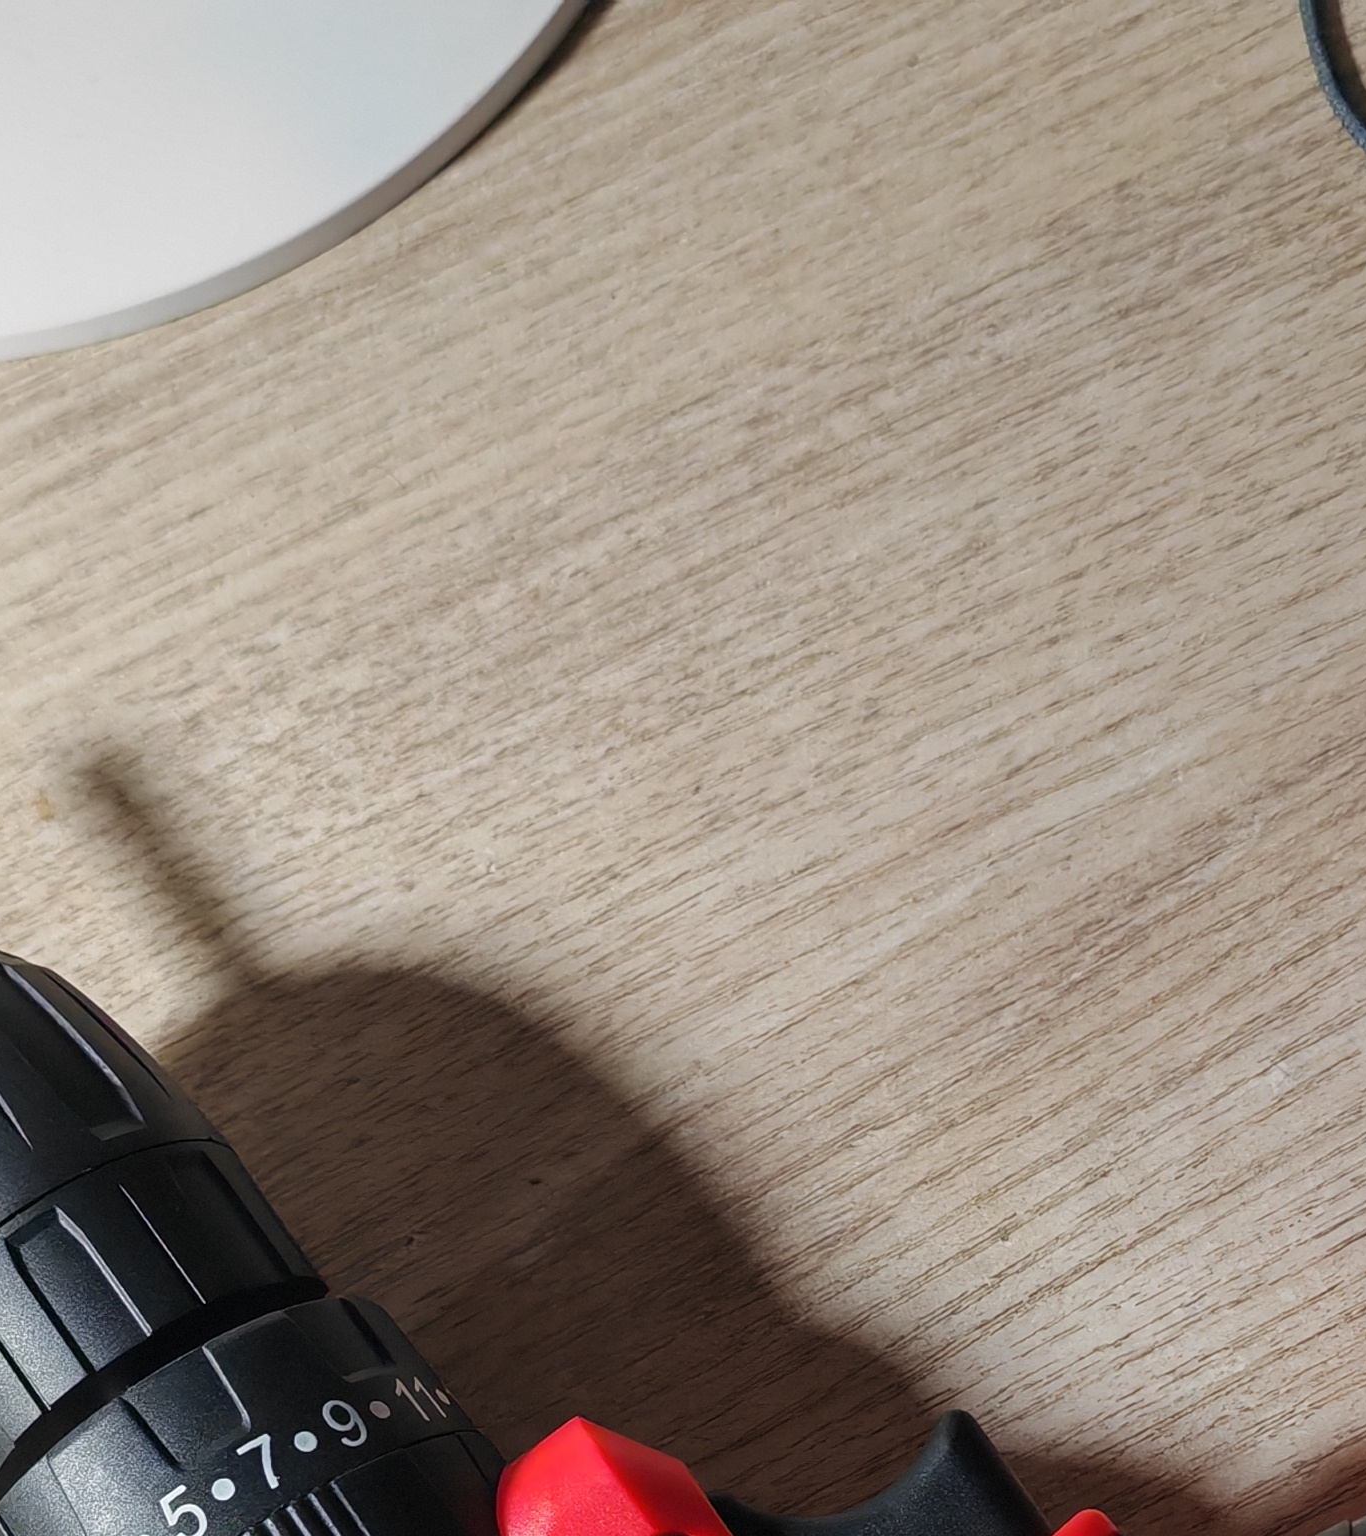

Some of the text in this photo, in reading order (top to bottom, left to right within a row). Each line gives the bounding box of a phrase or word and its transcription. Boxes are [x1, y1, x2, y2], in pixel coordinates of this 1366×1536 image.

[236, 1434, 279, 1489] 7
[322, 1400, 367, 1446] 9
[396, 1377, 446, 1421] 11
